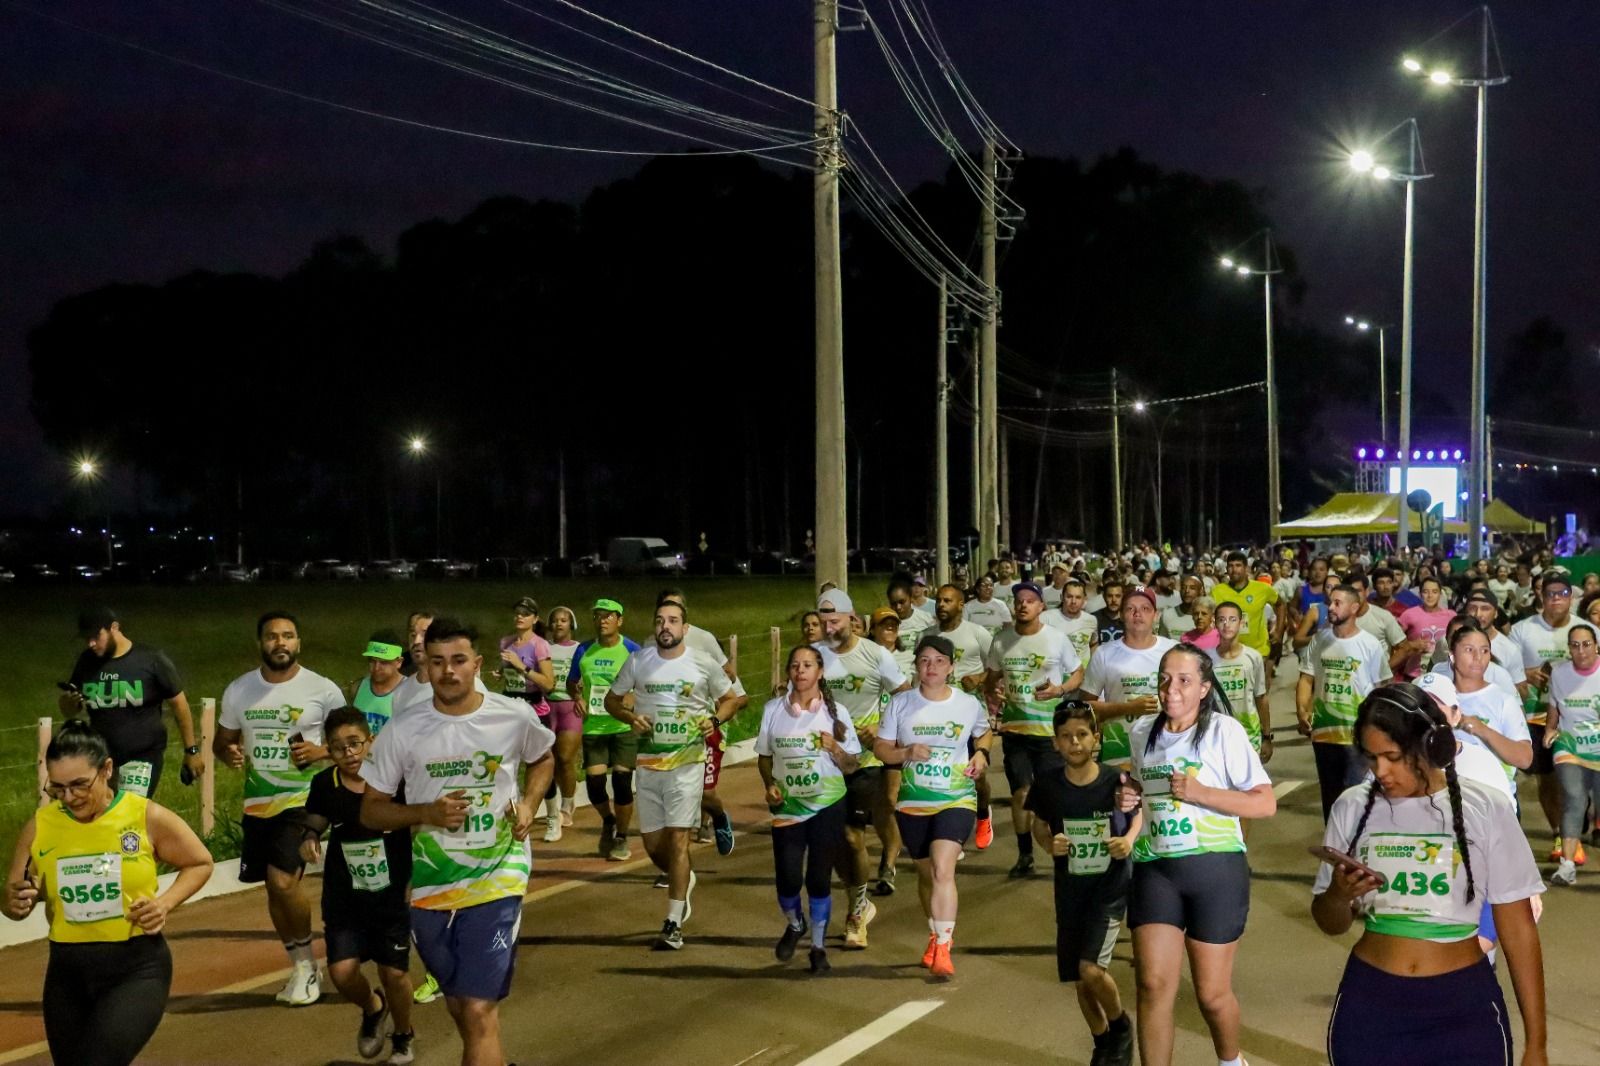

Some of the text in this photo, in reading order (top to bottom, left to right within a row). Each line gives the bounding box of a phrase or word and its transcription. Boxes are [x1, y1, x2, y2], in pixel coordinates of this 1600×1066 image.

[82, 680, 143, 709] RUN
[655, 723, 687, 734] 0186
[253, 746, 289, 760] 0373
[425, 760, 473, 771] SENADOR
[429, 768, 469, 778] CANEDO
[704, 746, 715, 785] BOSS
[786, 772, 819, 787] 0469
[447, 813, 494, 834] 119
[1150, 817, 1192, 837] 0426
[1068, 842, 1109, 858] 0375
[349, 860, 388, 878] 0634
[59, 882, 121, 904] 0565
